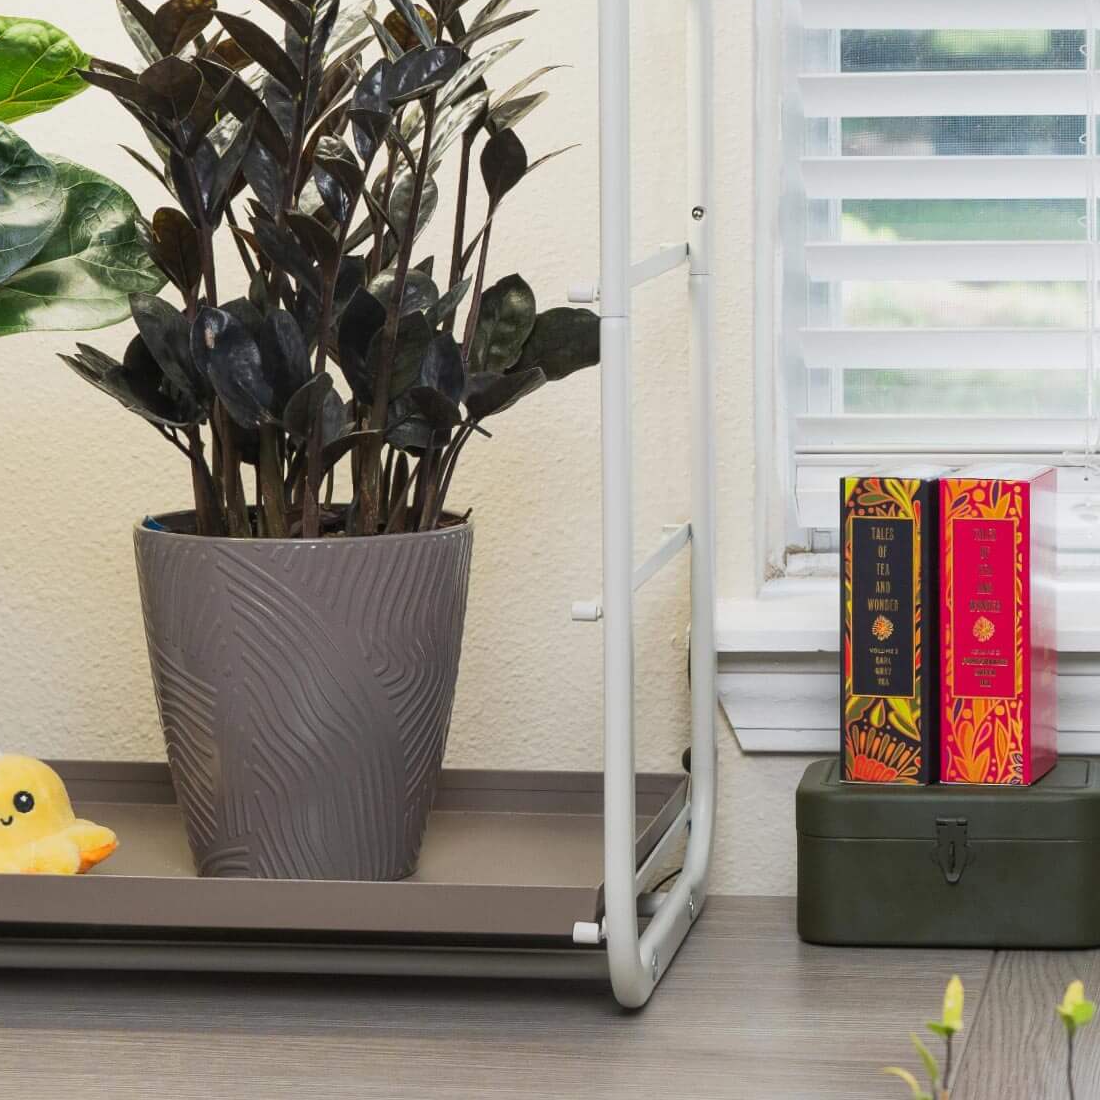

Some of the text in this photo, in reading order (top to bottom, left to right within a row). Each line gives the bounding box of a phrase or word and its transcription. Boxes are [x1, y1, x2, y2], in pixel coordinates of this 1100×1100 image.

[870, 526, 895, 541] TALES
[878, 545, 887, 558] OF
[875, 563, 891, 576] TEA
[875, 580, 891, 594] AND
[867, 598, 900, 612] WONDER
